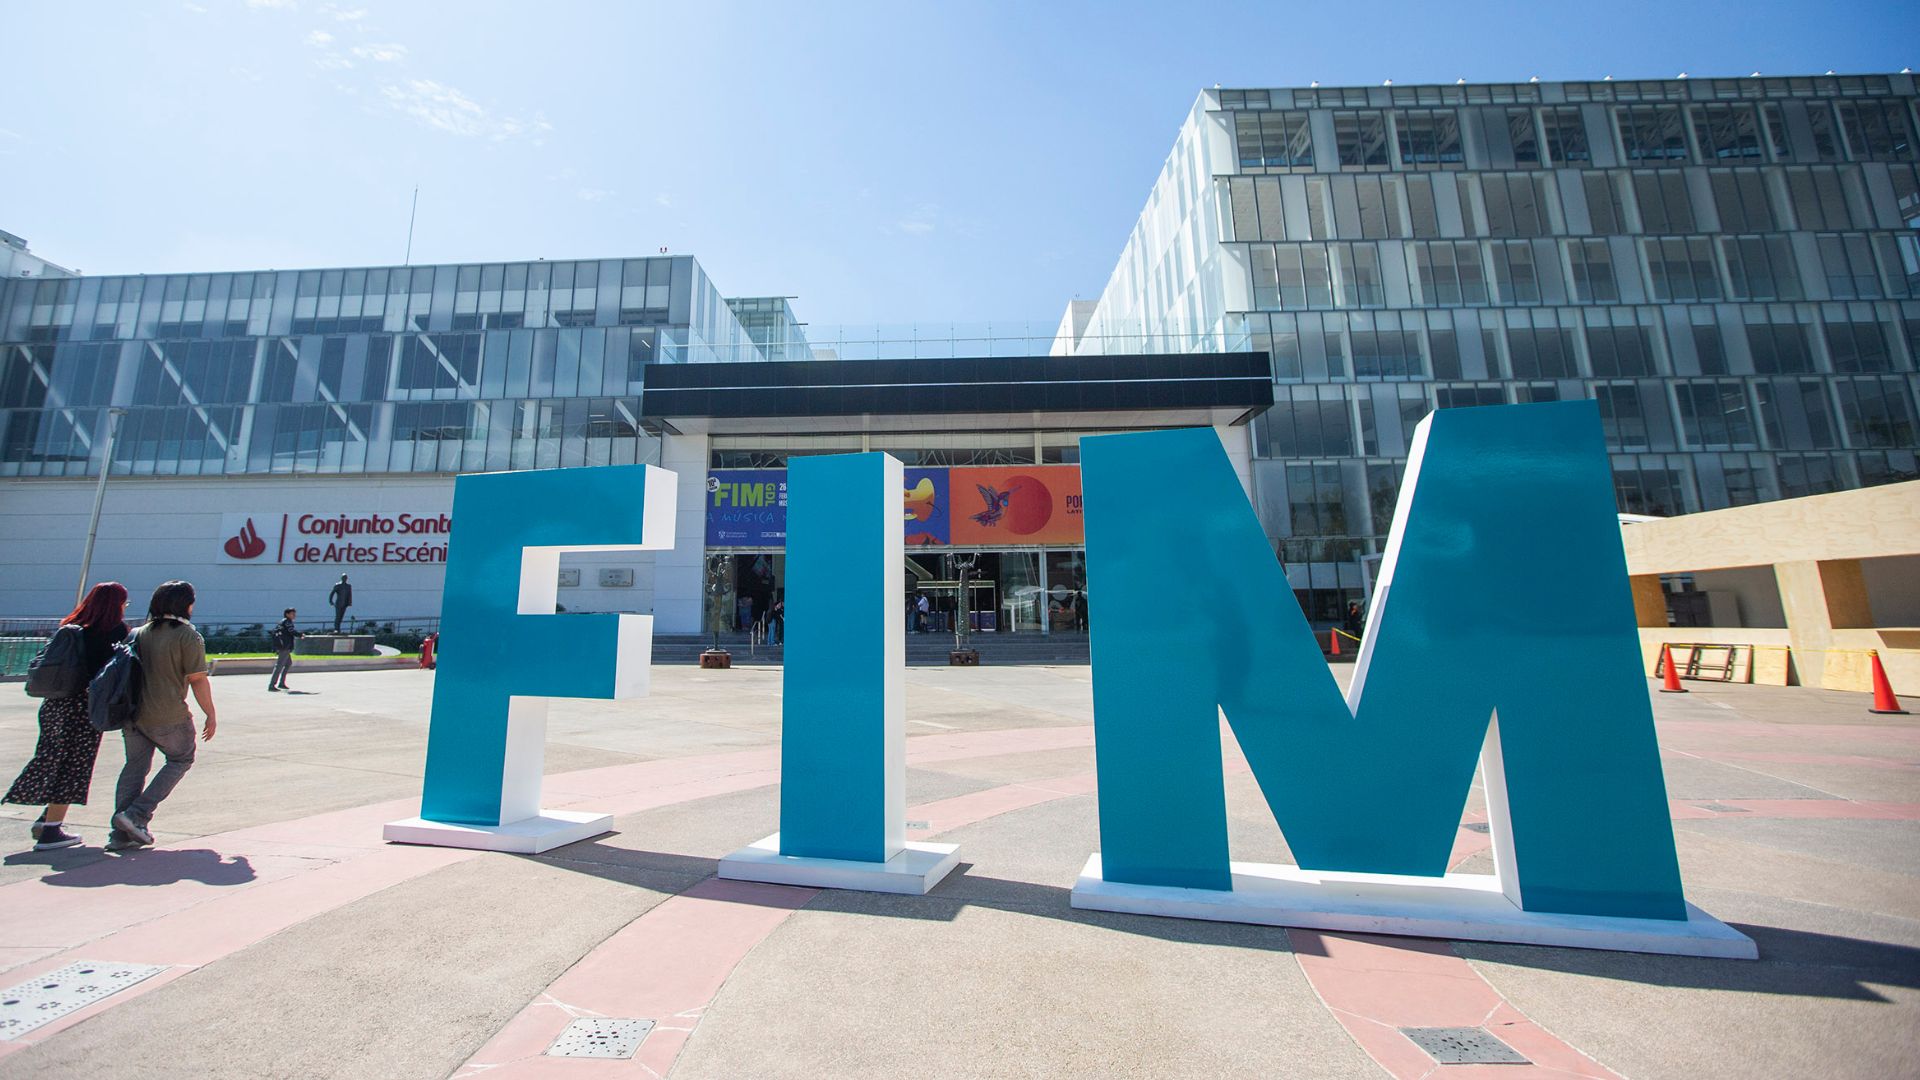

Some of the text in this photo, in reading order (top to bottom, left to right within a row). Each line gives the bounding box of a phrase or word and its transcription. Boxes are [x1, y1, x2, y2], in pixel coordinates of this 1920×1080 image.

[715, 483, 764, 507] FIM
[765, 483, 776, 507] GDL
[298, 514, 394, 539] Conjunto
[294, 542, 448, 563] de Artes Escéni
[420, 400, 1687, 920] FIM
